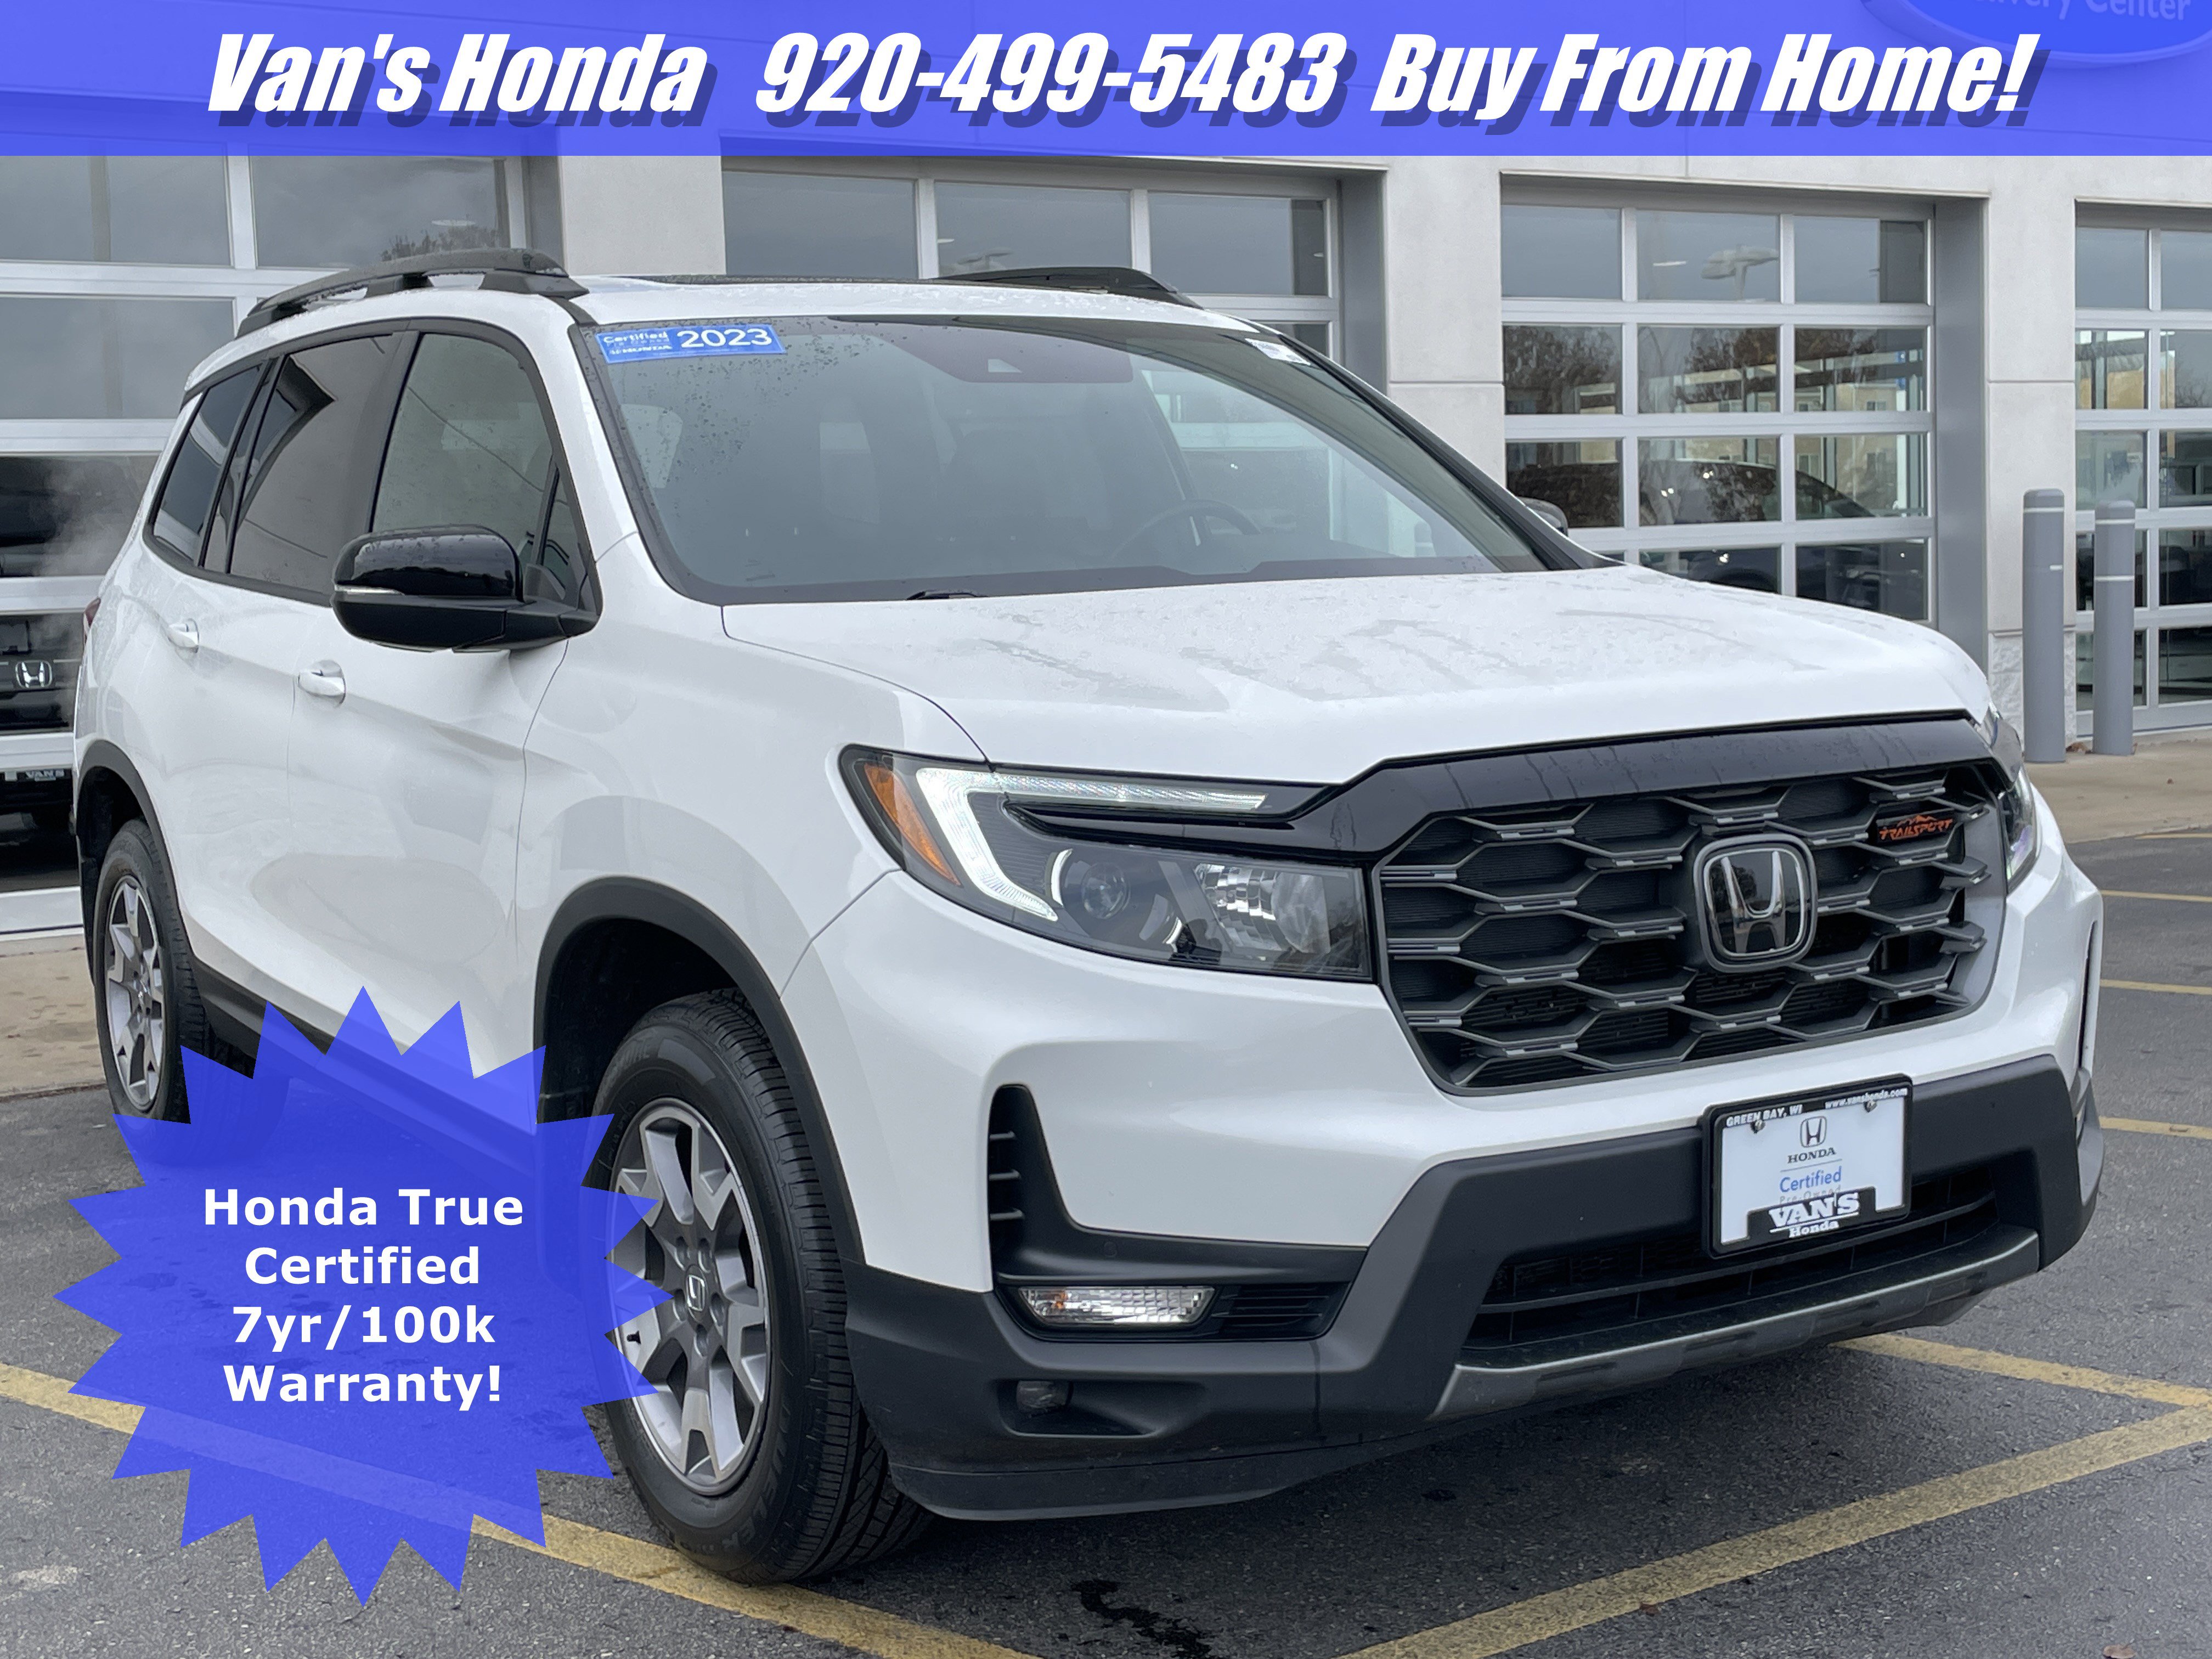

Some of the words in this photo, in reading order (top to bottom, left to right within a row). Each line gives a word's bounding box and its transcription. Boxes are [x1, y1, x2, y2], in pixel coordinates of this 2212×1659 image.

[603, 331, 668, 343] Certified
[677, 329, 772, 348] 2023
[1879, 819, 1953, 840] TRAILSPORT
[1825, 1088, 1908, 1109] www.vanshonda.com
[1726, 1111, 1761, 1127] GREEN
[1790, 1104, 1803, 1115] WI
[1787, 1147, 1837, 1164] HONDA
[1779, 1166, 1842, 1192] Certified
[1788, 1221, 1839, 1238] Honda
